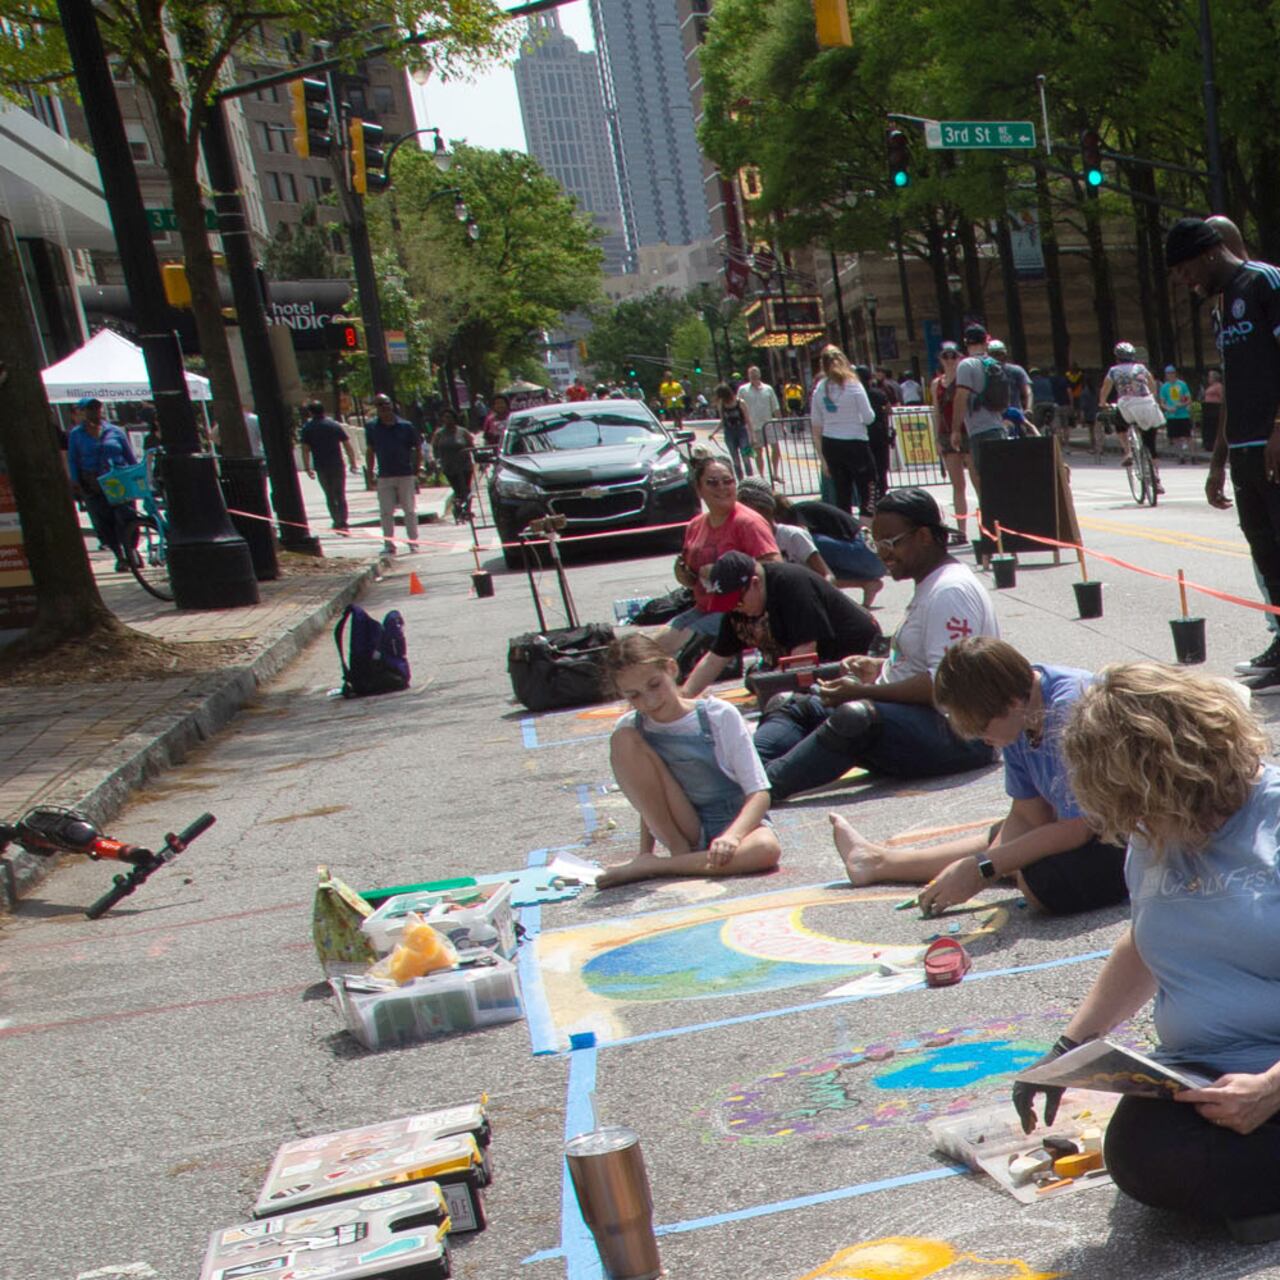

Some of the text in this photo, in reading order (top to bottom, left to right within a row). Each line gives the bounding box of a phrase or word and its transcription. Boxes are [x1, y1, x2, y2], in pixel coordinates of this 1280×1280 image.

[945, 126, 969, 144] 3rd
[975, 126, 991, 144] St
[272, 301, 316, 315] hotel
